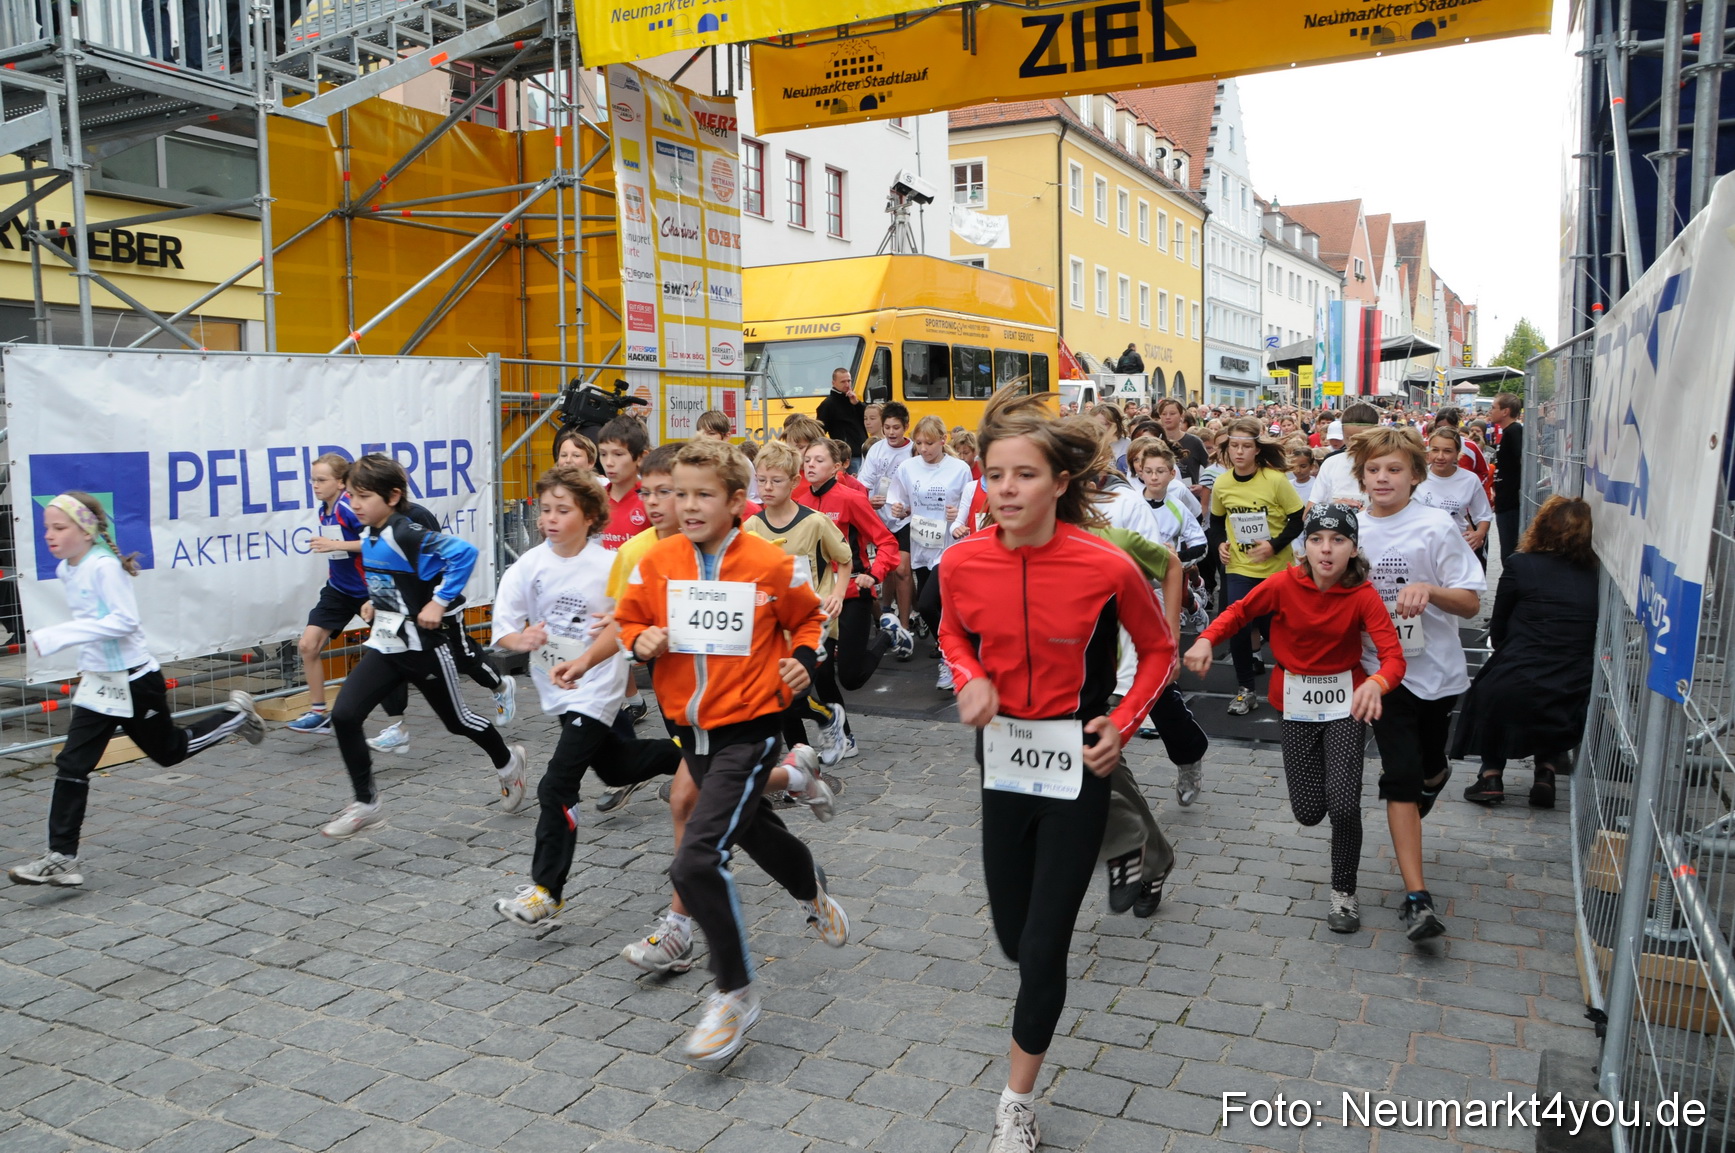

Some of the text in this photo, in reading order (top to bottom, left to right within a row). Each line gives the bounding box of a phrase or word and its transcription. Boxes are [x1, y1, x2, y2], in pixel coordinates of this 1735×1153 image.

[611, 0, 696, 24] Neumarkter
[1303, 3, 1414, 29] Neumarkter
[1019, 0, 1198, 79] ZIEL
[782, 66, 929, 100] Neumarkter Stadtlauf
[693, 110, 738, 132] MERZ
[707, 227, 741, 250] OBI
[710, 284, 733, 301] MCM
[784, 321, 842, 336] TIMING
[925, 317, 957, 331] SPORTRONIC
[1003, 329, 1017, 340] EVENT
[1017, 331, 1035, 343] SERVICE
[627, 352, 657, 363] HACKNER
[631, 345, 657, 354] INTERSPORT
[711, 346, 731, 354] GERHART
[670, 396, 704, 413] Sinupret
[670, 414, 691, 428] forte
[168, 439, 477, 520] PFLEIRER
[918, 528, 942, 540] 4115
[1240, 523, 1264, 534] 4097
[689, 586, 727, 602] Florian
[688, 609, 744, 632] 4095
[1301, 674, 1338, 685] Vanessa
[1302, 688, 1346, 705] 4000
[1007, 722, 1033, 740] Tina
[1010, 747, 1072, 771] 4079
